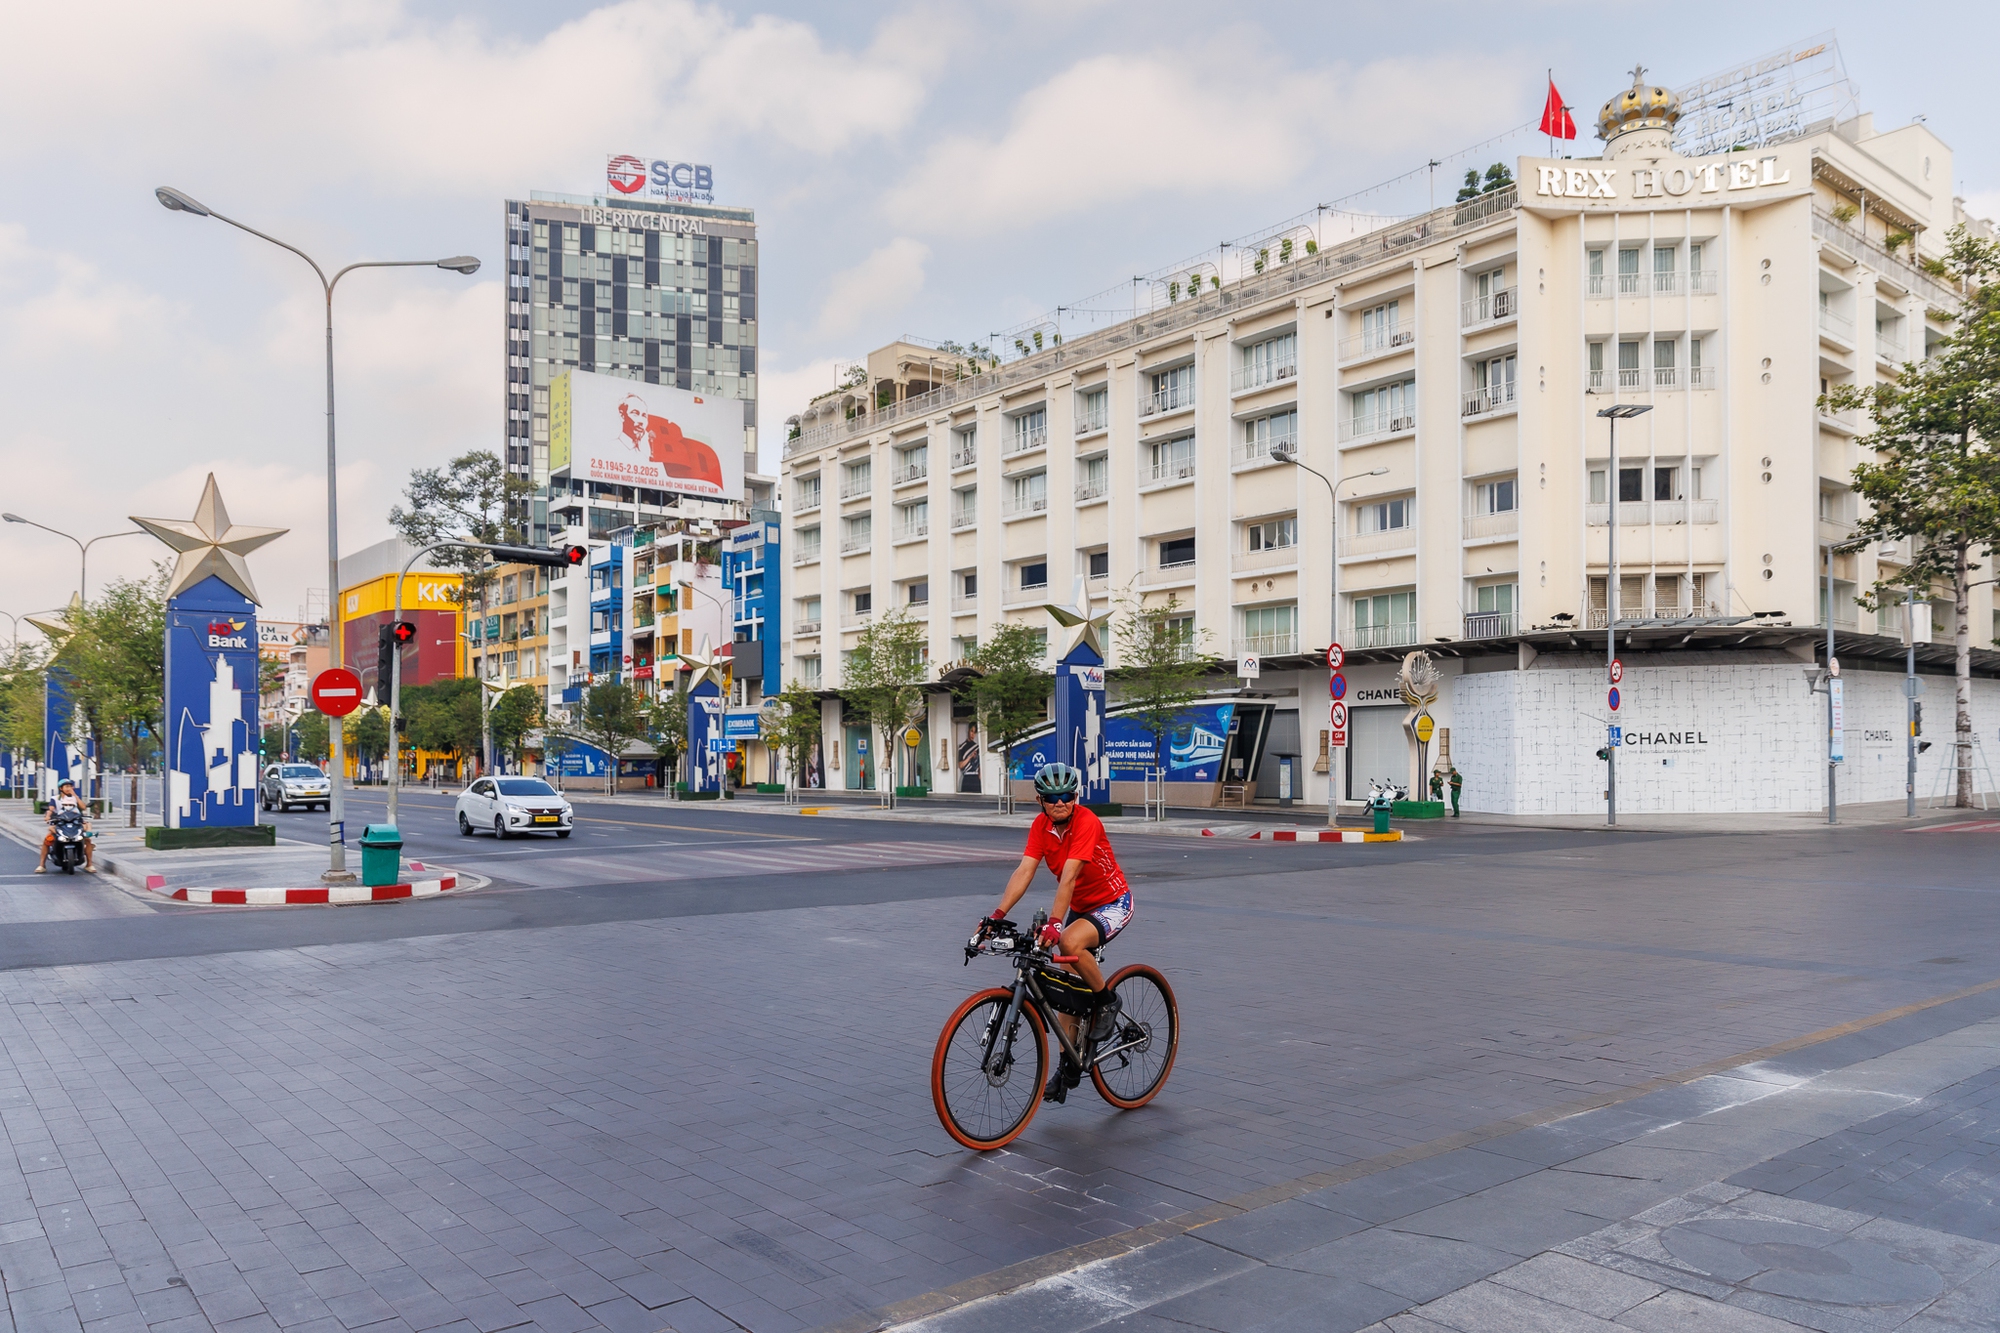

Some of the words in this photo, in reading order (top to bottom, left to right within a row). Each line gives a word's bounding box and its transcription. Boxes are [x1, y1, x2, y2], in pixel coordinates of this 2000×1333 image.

[1764, 113, 1799, 136] BAR
[651, 160, 713, 190] SCB
[1537, 166, 1617, 198] REX
[1633, 155, 1791, 198] HOTEL
[580, 208, 640, 227] LIBERTY
[640, 214, 706, 235] CENTRAL
[590, 458, 659, 477] 2.9.1945-2.9.2025
[604, 471, 620, 480] KHÁNH
[708, 486, 719, 494] NAM
[208, 623, 232, 636] HD
[260, 625, 276, 634] IM
[208, 634, 248, 649] Bank
[260, 633, 289, 643] GAN
[938, 660, 955, 677] REX
[1357, 688, 1400, 700] CHANE
[727, 719, 755, 728] EXIMBANK
[1625, 731, 1708, 745] CHANEL
[1864, 729, 1893, 741] CHANEL
[1125, 751, 1137, 760] NHẸ
